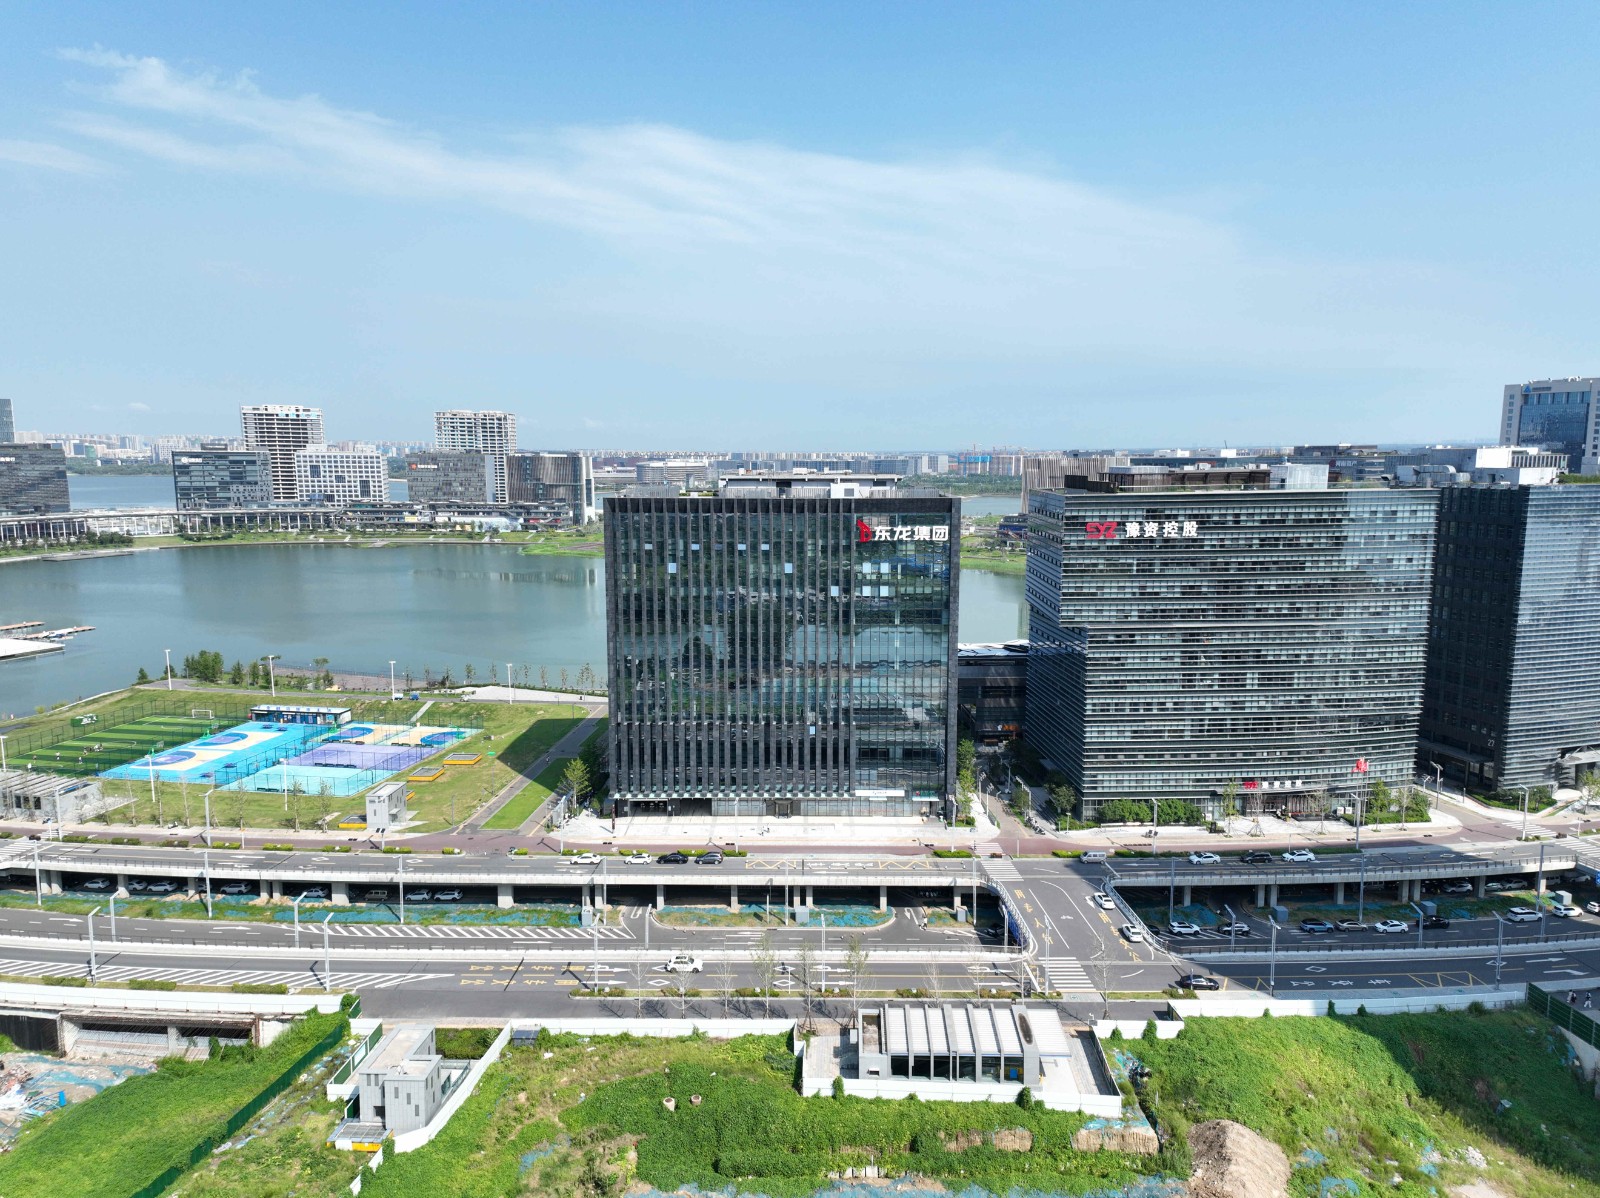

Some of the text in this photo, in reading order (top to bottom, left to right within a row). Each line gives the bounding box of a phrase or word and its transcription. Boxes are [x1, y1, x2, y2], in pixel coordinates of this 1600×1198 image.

[873, 525, 949, 541] 东龙集团
[1124, 521, 1199, 538] 豫资控股
